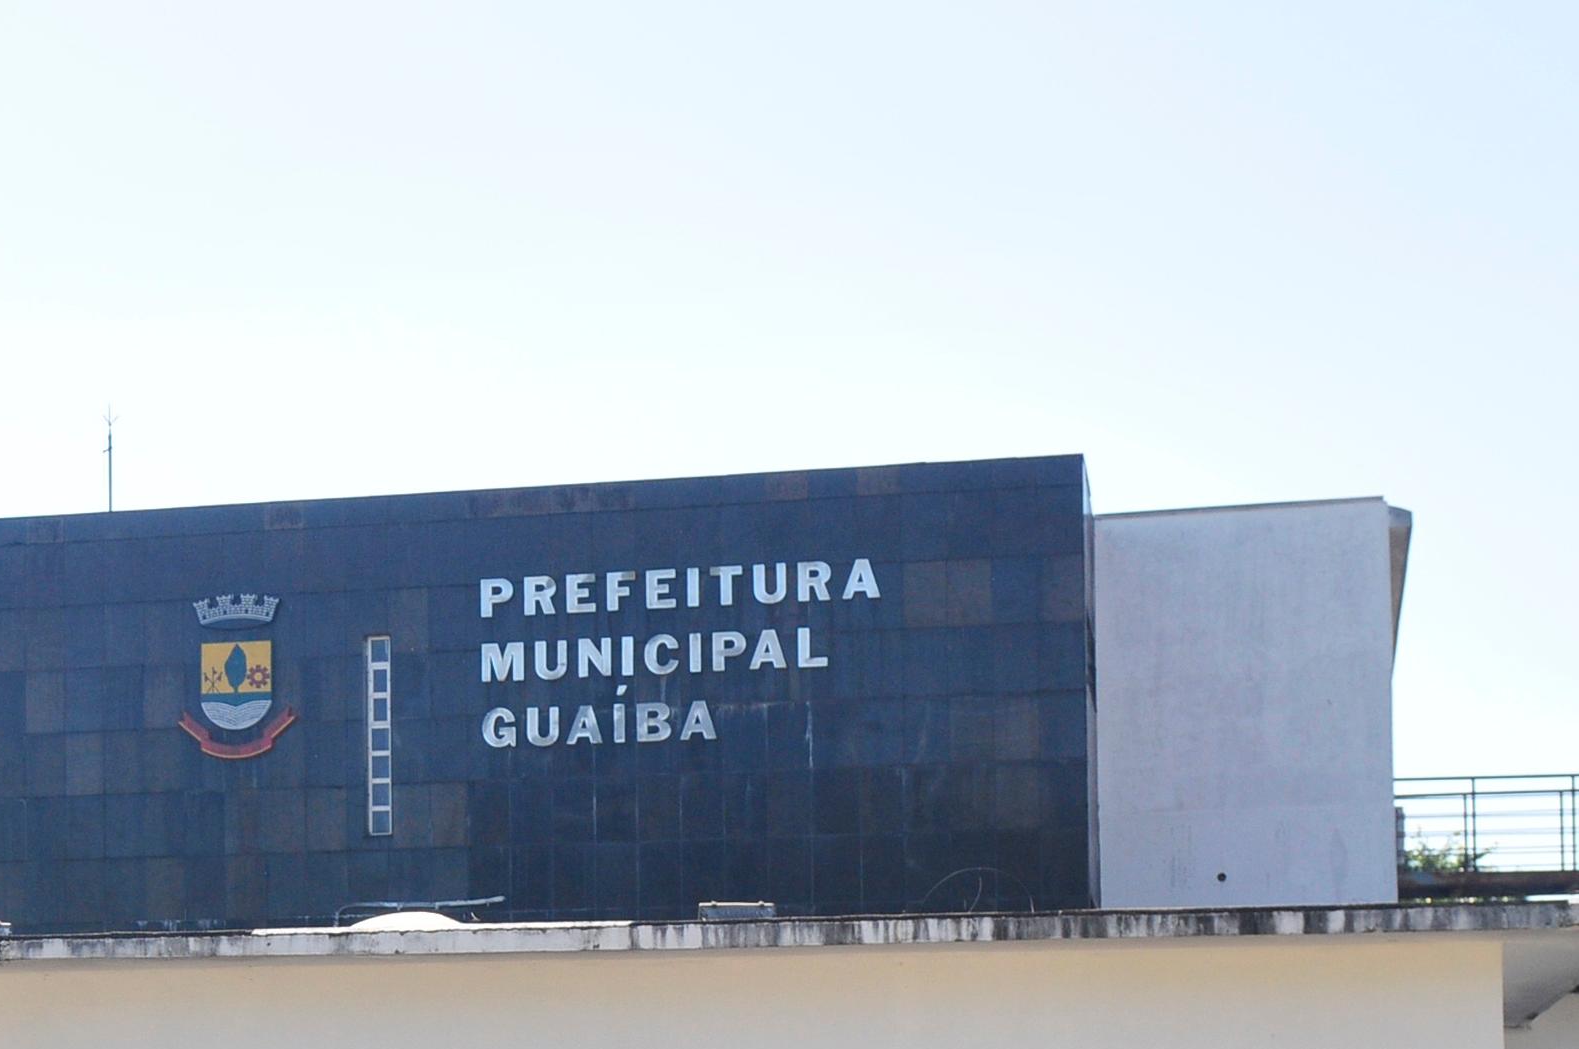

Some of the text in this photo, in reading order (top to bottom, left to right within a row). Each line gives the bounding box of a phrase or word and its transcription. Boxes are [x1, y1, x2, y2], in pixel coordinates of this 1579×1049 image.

[480, 558, 881, 618] PREFEITURA
[480, 627, 829, 683] MUNICIPAL
[482, 684, 717, 748] GUAÍBA
